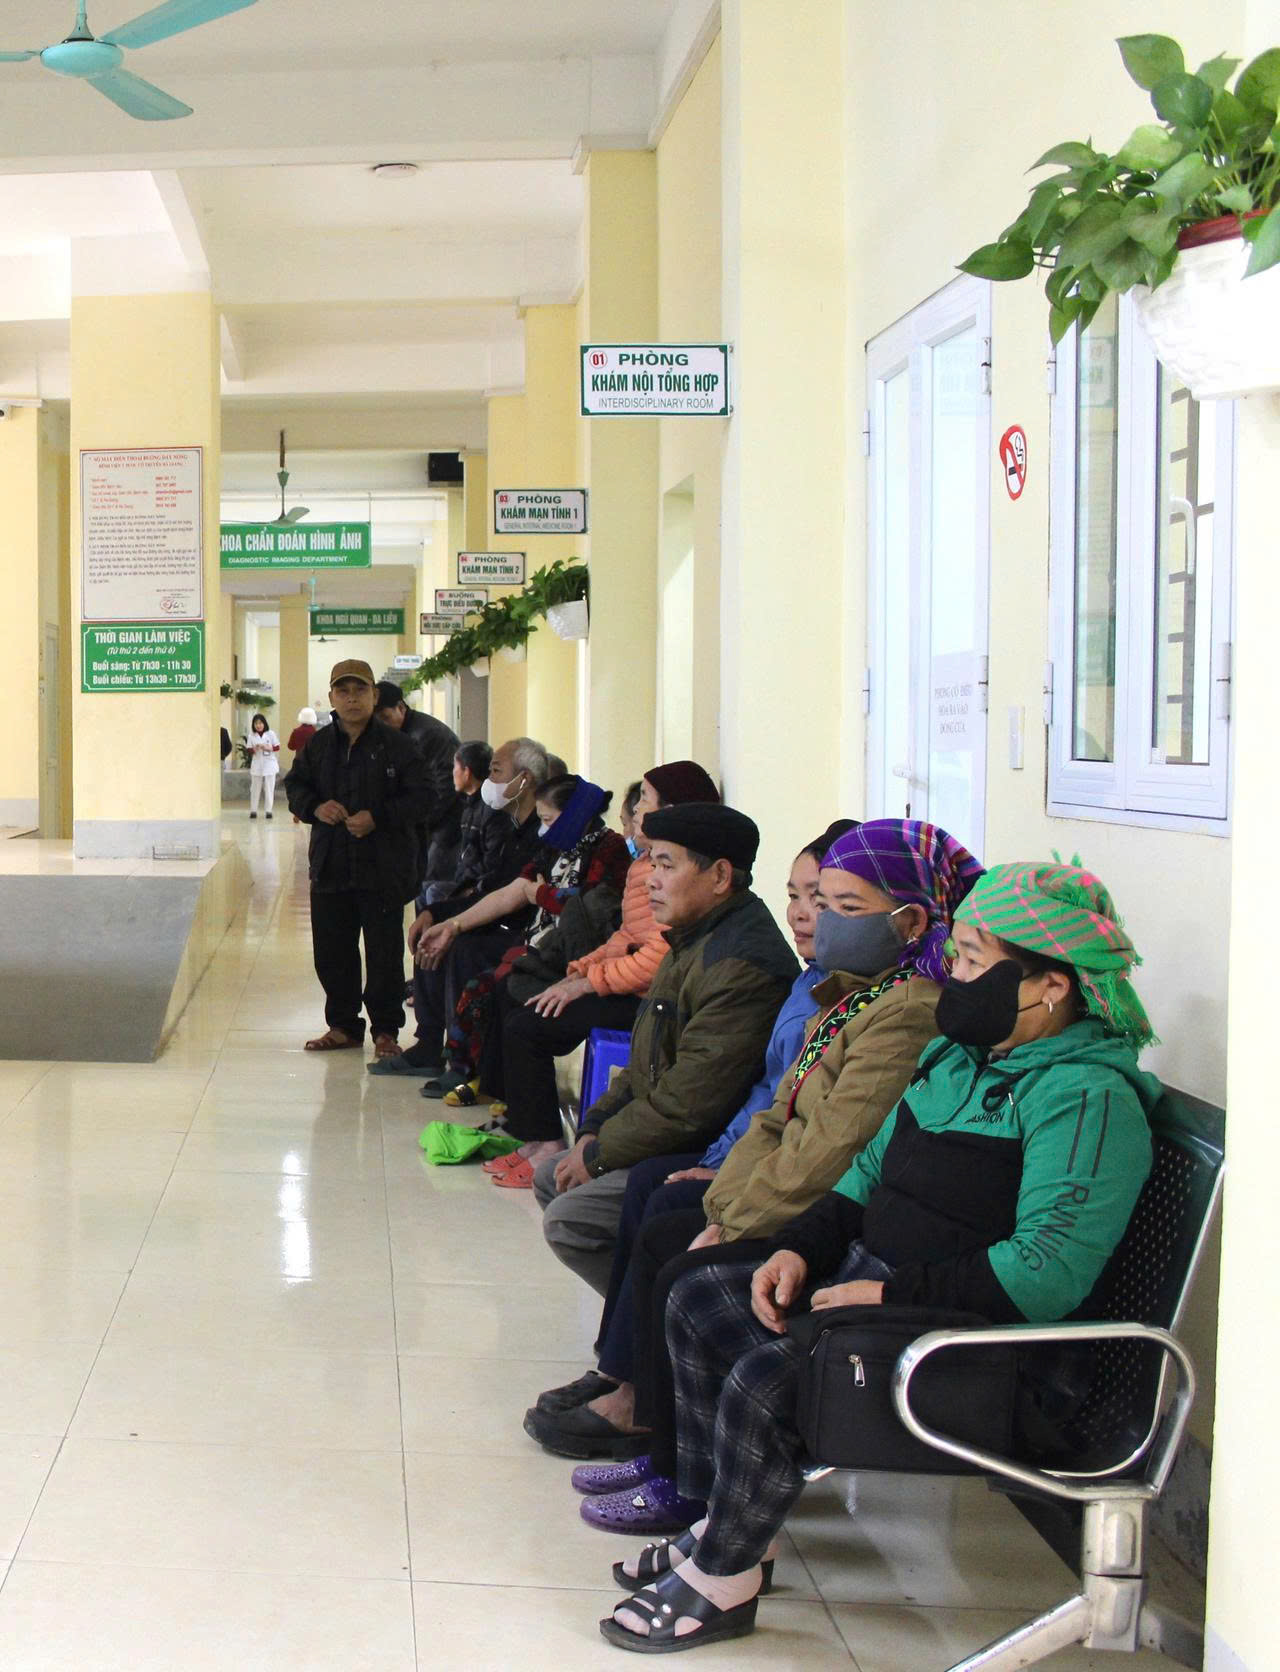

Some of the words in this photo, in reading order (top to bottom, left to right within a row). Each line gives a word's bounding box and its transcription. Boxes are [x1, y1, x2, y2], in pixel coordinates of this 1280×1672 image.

[592, 354, 605, 365] 01
[618, 350, 689, 366] PHÒNG
[591, 370, 628, 392] KHÁM
[632, 370, 654, 395] NỘI
[657, 367, 690, 392] TỔNG
[694, 373, 719, 396] HỢP
[598, 398, 684, 409] INTERDISCIPLINARY
[687, 398, 714, 409] ROOM
[517, 493, 562, 504] PHÒNG
[500, 505, 526, 519] KHÁM
[528, 507, 549, 521] MẠN
[551, 506, 571, 519] TÍNH
[573, 508, 578, 519] 1
[220, 534, 242, 551] HOA
[245, 526, 274, 551] CHẨN
[278, 530, 306, 550] ĐOÁN
[310, 530, 336, 550] HÌNH
[340, 526, 362, 550] ẢNH
[474, 555, 507, 563] PHÒNG
[462, 564, 481, 574] KHÁM
[515, 566, 520, 574] 2
[94, 629, 116, 643] THỜI
[119, 631, 143, 643] GIAN
[145, 629, 166, 643] LÀM
[169, 629, 191, 645] VIỆC
[92, 659, 109, 671] Buổi
[142, 660, 160, 670] 7h30
[167, 660, 180, 670] 11h
[181, 660, 191, 670] 30
[92, 673, 109, 685] Buổi
[145, 674, 167, 684] 13h30
[174, 674, 196, 684] 17h30
